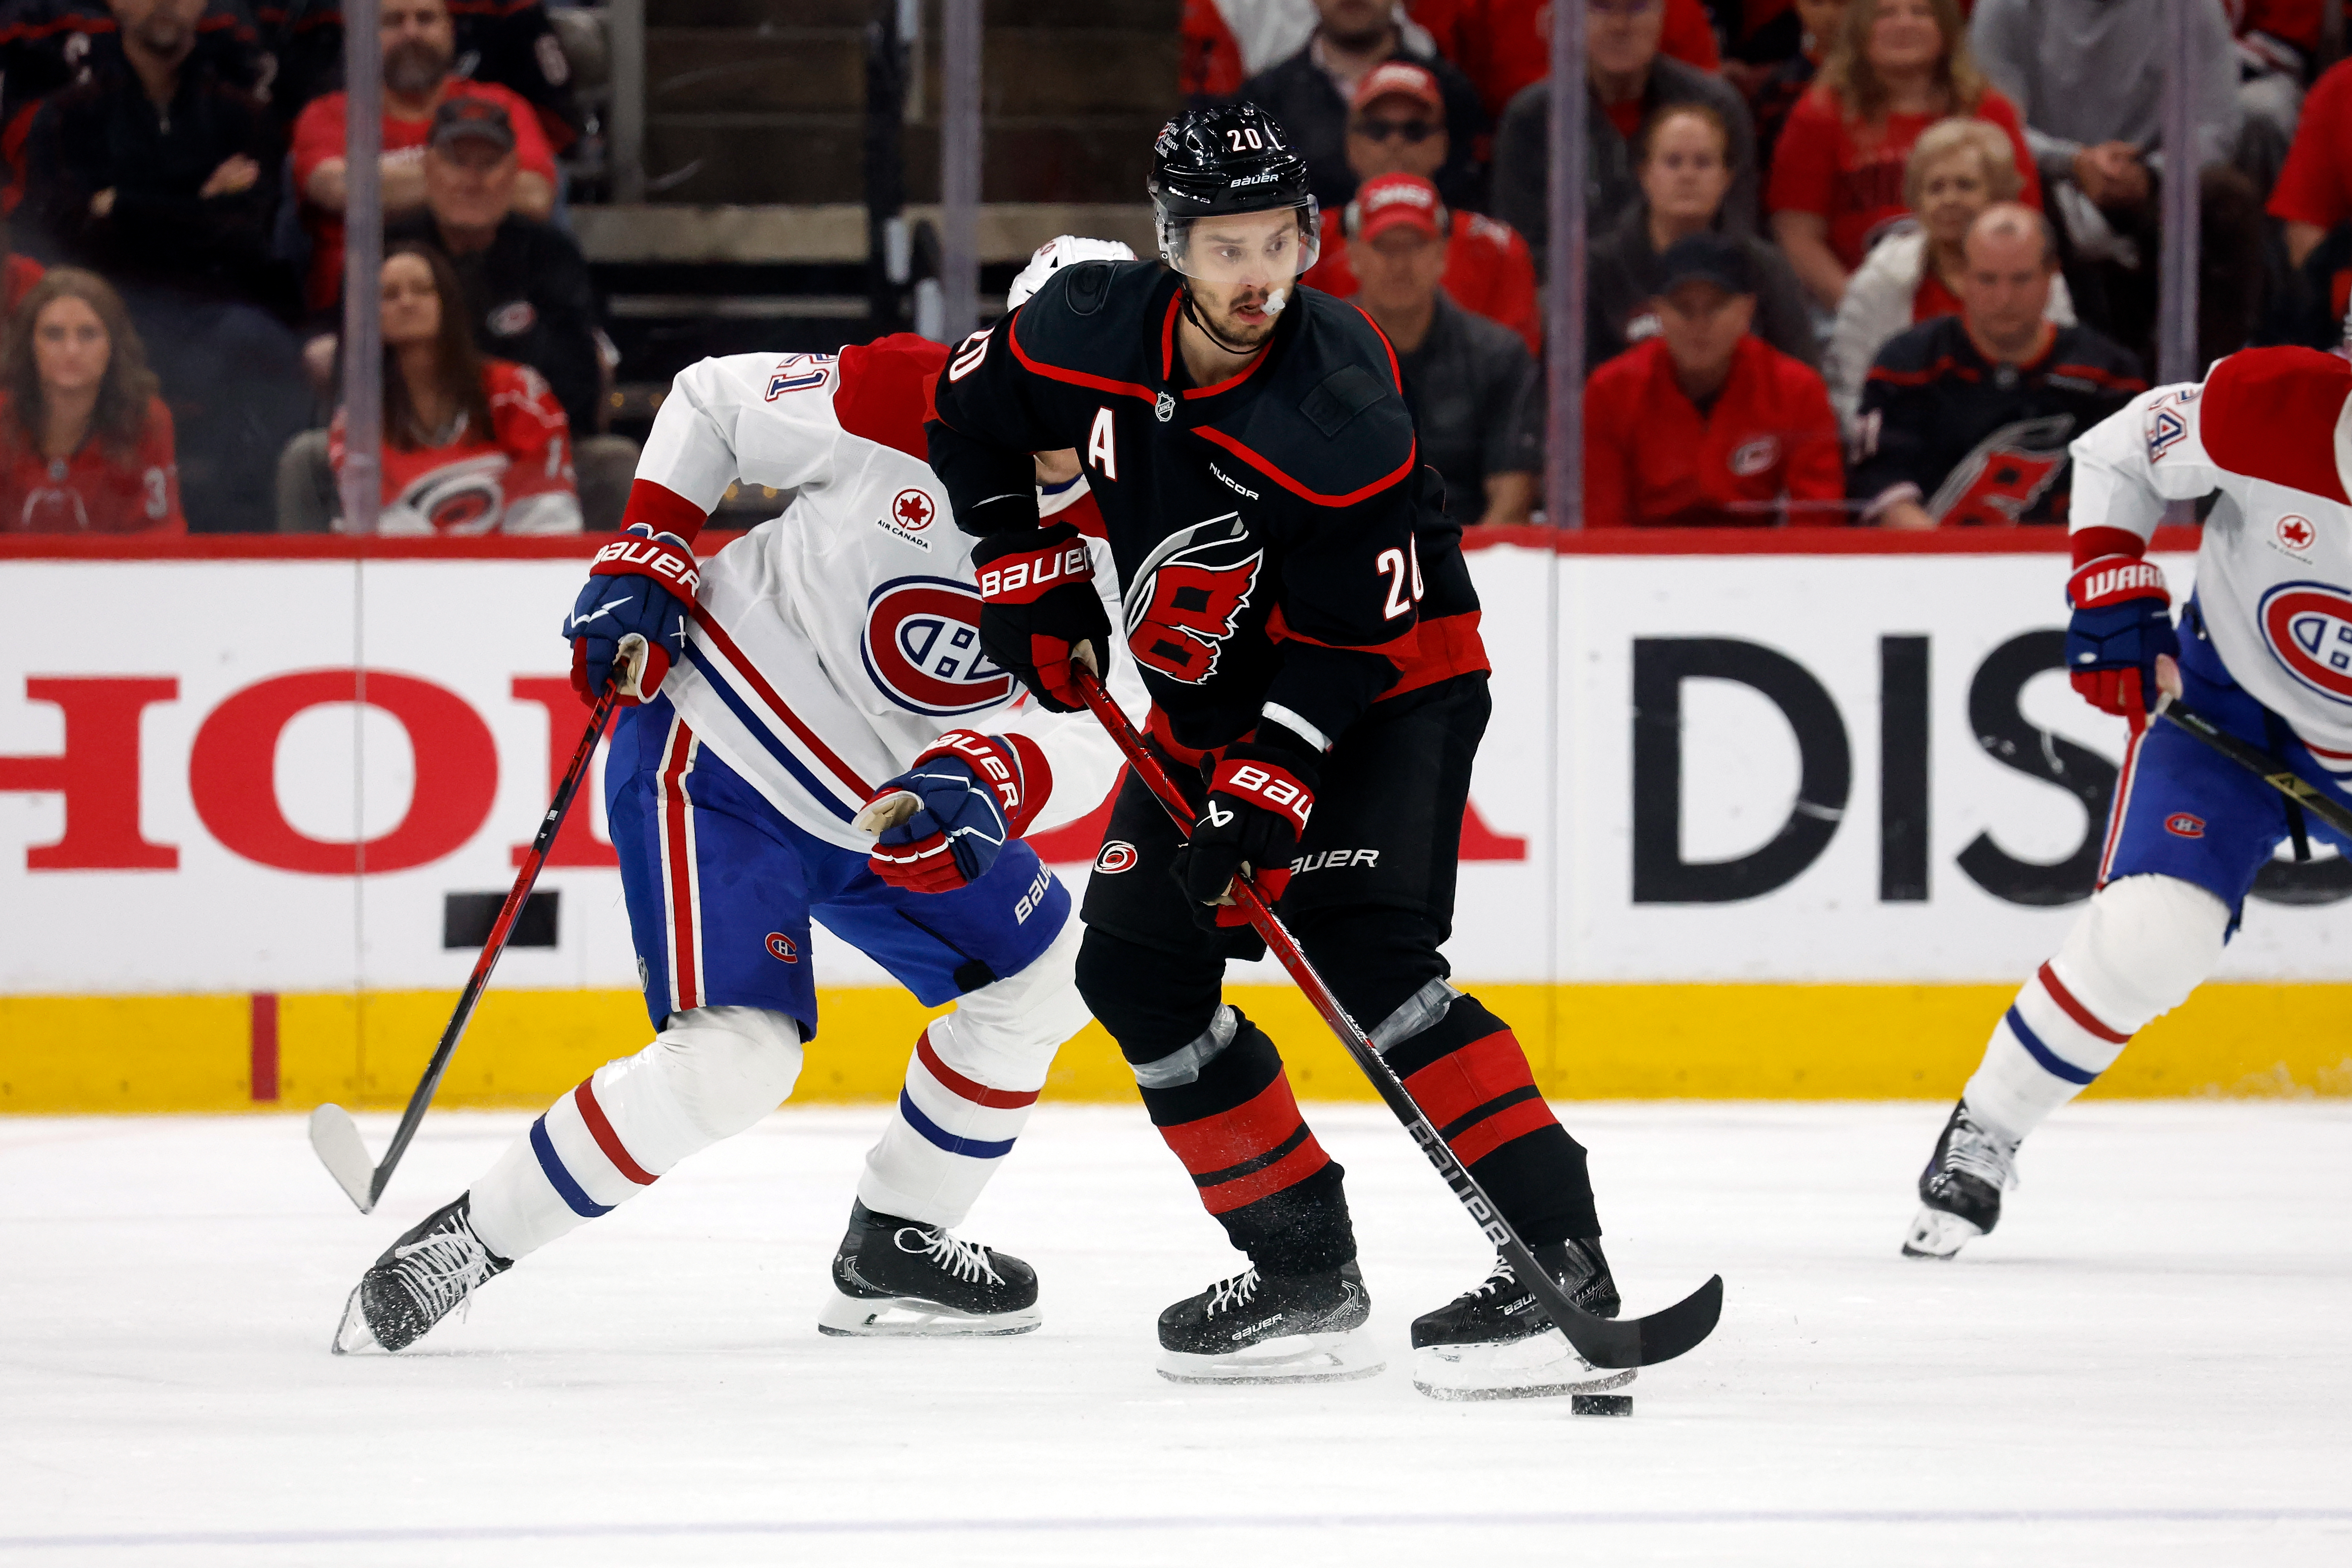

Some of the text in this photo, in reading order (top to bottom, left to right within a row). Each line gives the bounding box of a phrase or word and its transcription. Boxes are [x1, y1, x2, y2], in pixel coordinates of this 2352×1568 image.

[1226, 128, 1263, 152] 20
[1088, 406, 1117, 482] A
[1209, 462, 1259, 500] NUCOR
[878, 520, 928, 550] AIR CANADA
[1231, 1313, 1283, 1341] BAUER
